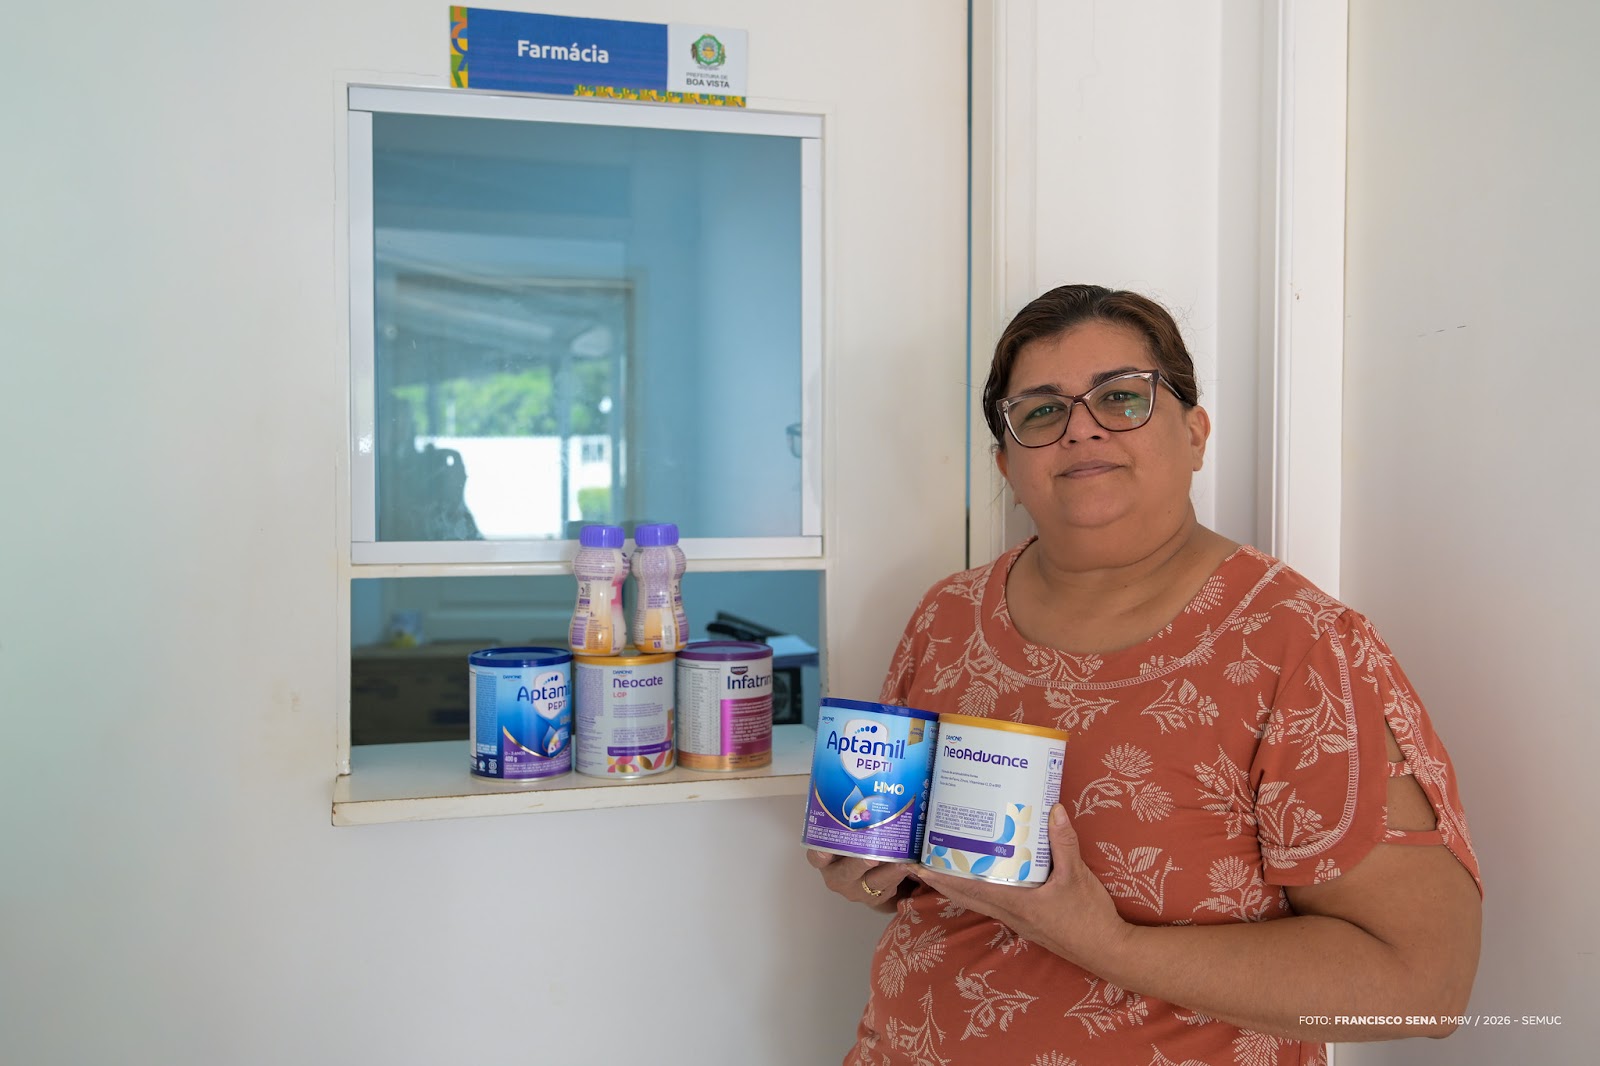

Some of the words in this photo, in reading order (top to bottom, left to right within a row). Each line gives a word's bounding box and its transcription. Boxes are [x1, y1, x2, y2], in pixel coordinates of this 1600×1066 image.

[517, 39, 610, 64] Farmácia
[686, 78, 705, 86] BOA
[706, 80, 730, 88] VISTA
[826, 730, 905, 760] Aptamil
[945, 734, 963, 742] DANONE
[856, 757, 893, 773] PEPTI
[873, 780, 905, 796] HMO
